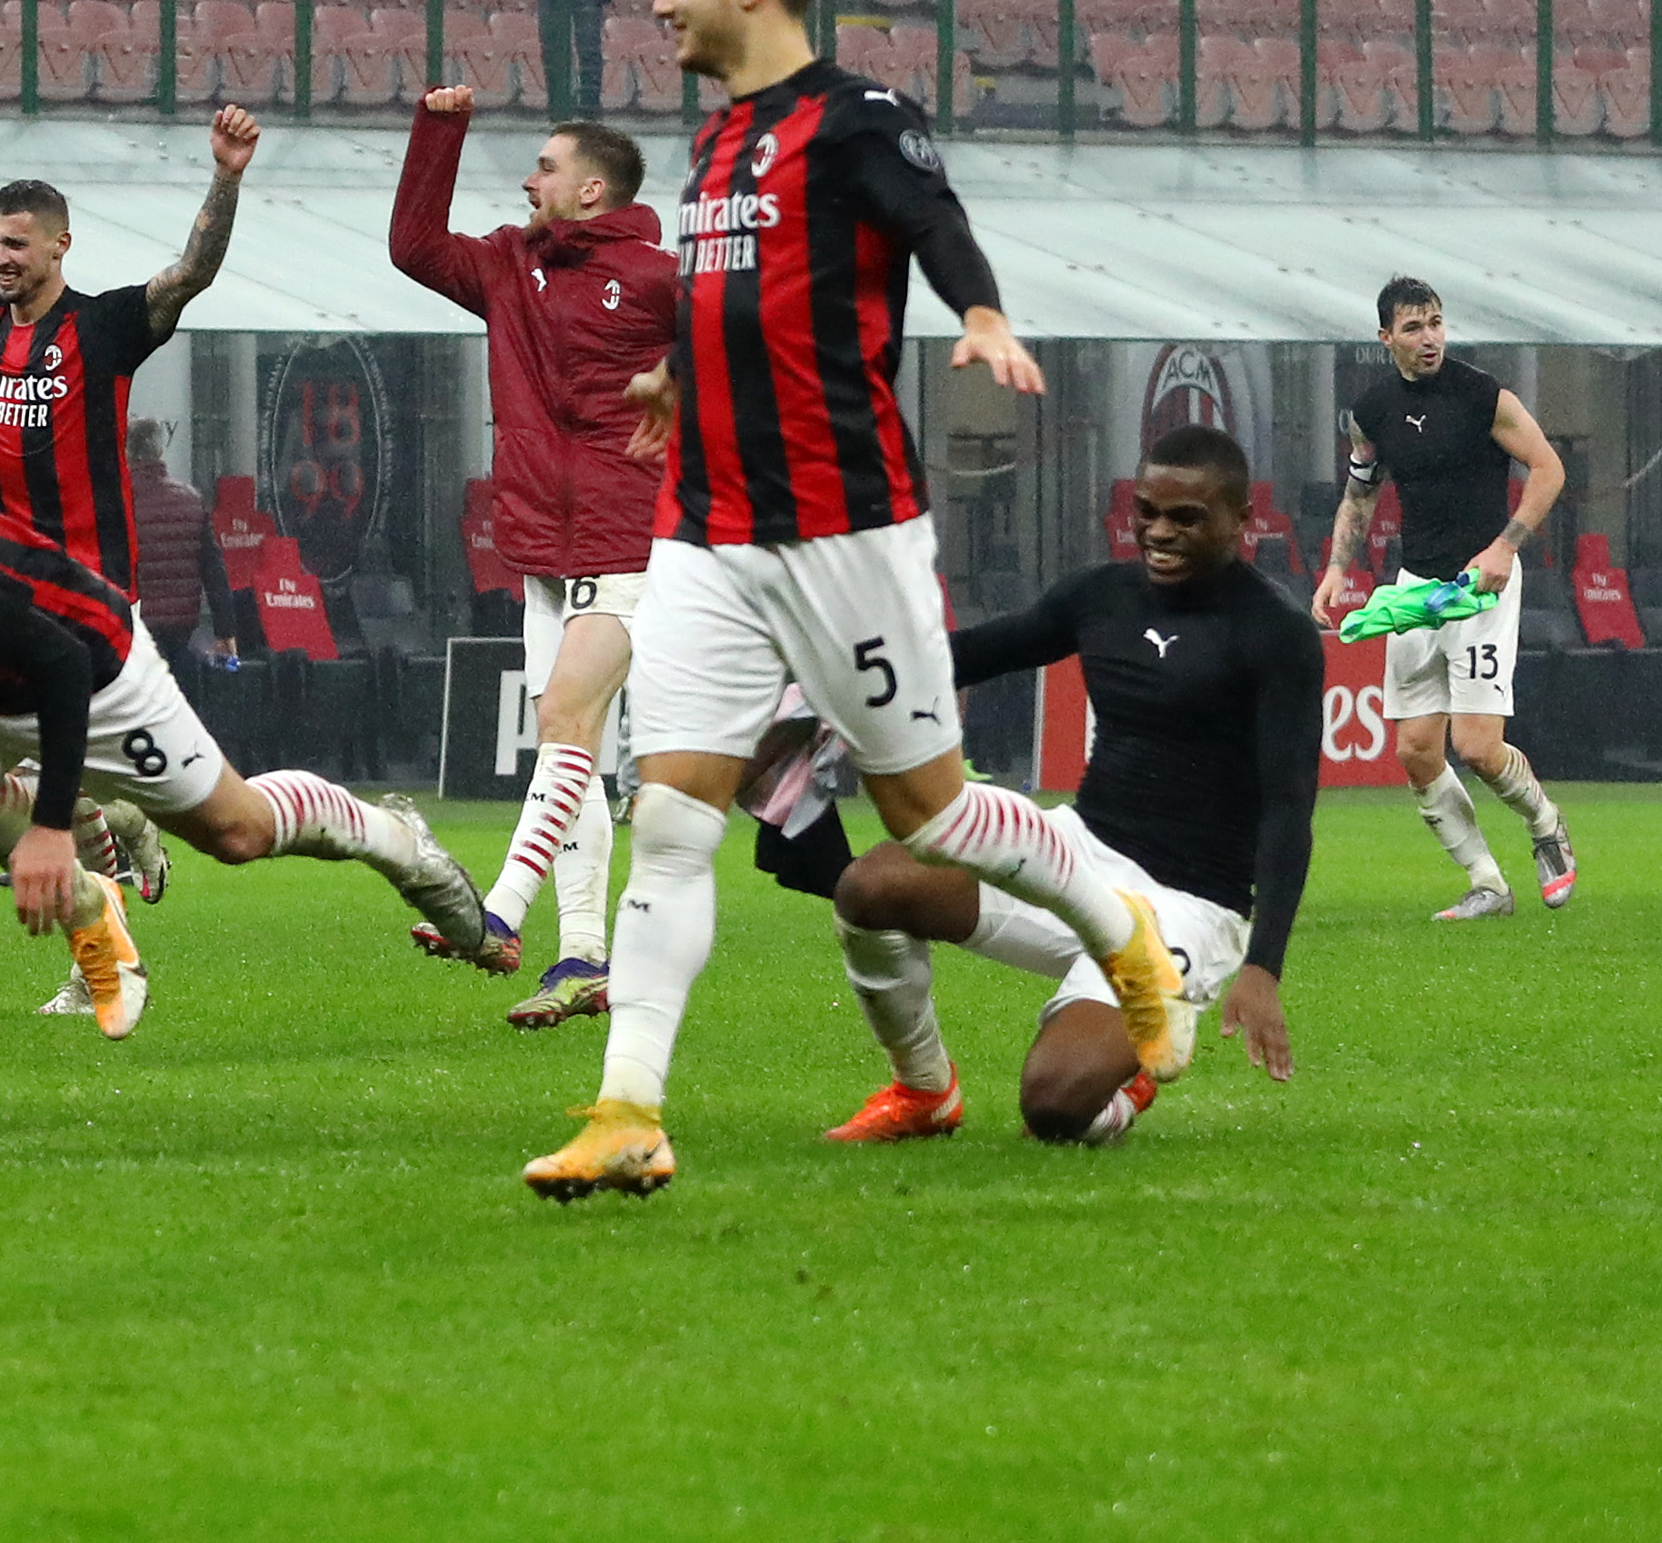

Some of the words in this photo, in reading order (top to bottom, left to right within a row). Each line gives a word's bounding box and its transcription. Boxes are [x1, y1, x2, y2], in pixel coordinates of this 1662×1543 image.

[694, 232, 753, 270] BETTER
[1162, 350, 1212, 389] ACM
[264, 593, 315, 609] Emirates
[279, 577, 296, 593] Fly
[854, 635, 897, 707] 5
[1466, 644, 1499, 680] 13
[122, 728, 167, 777] 8
